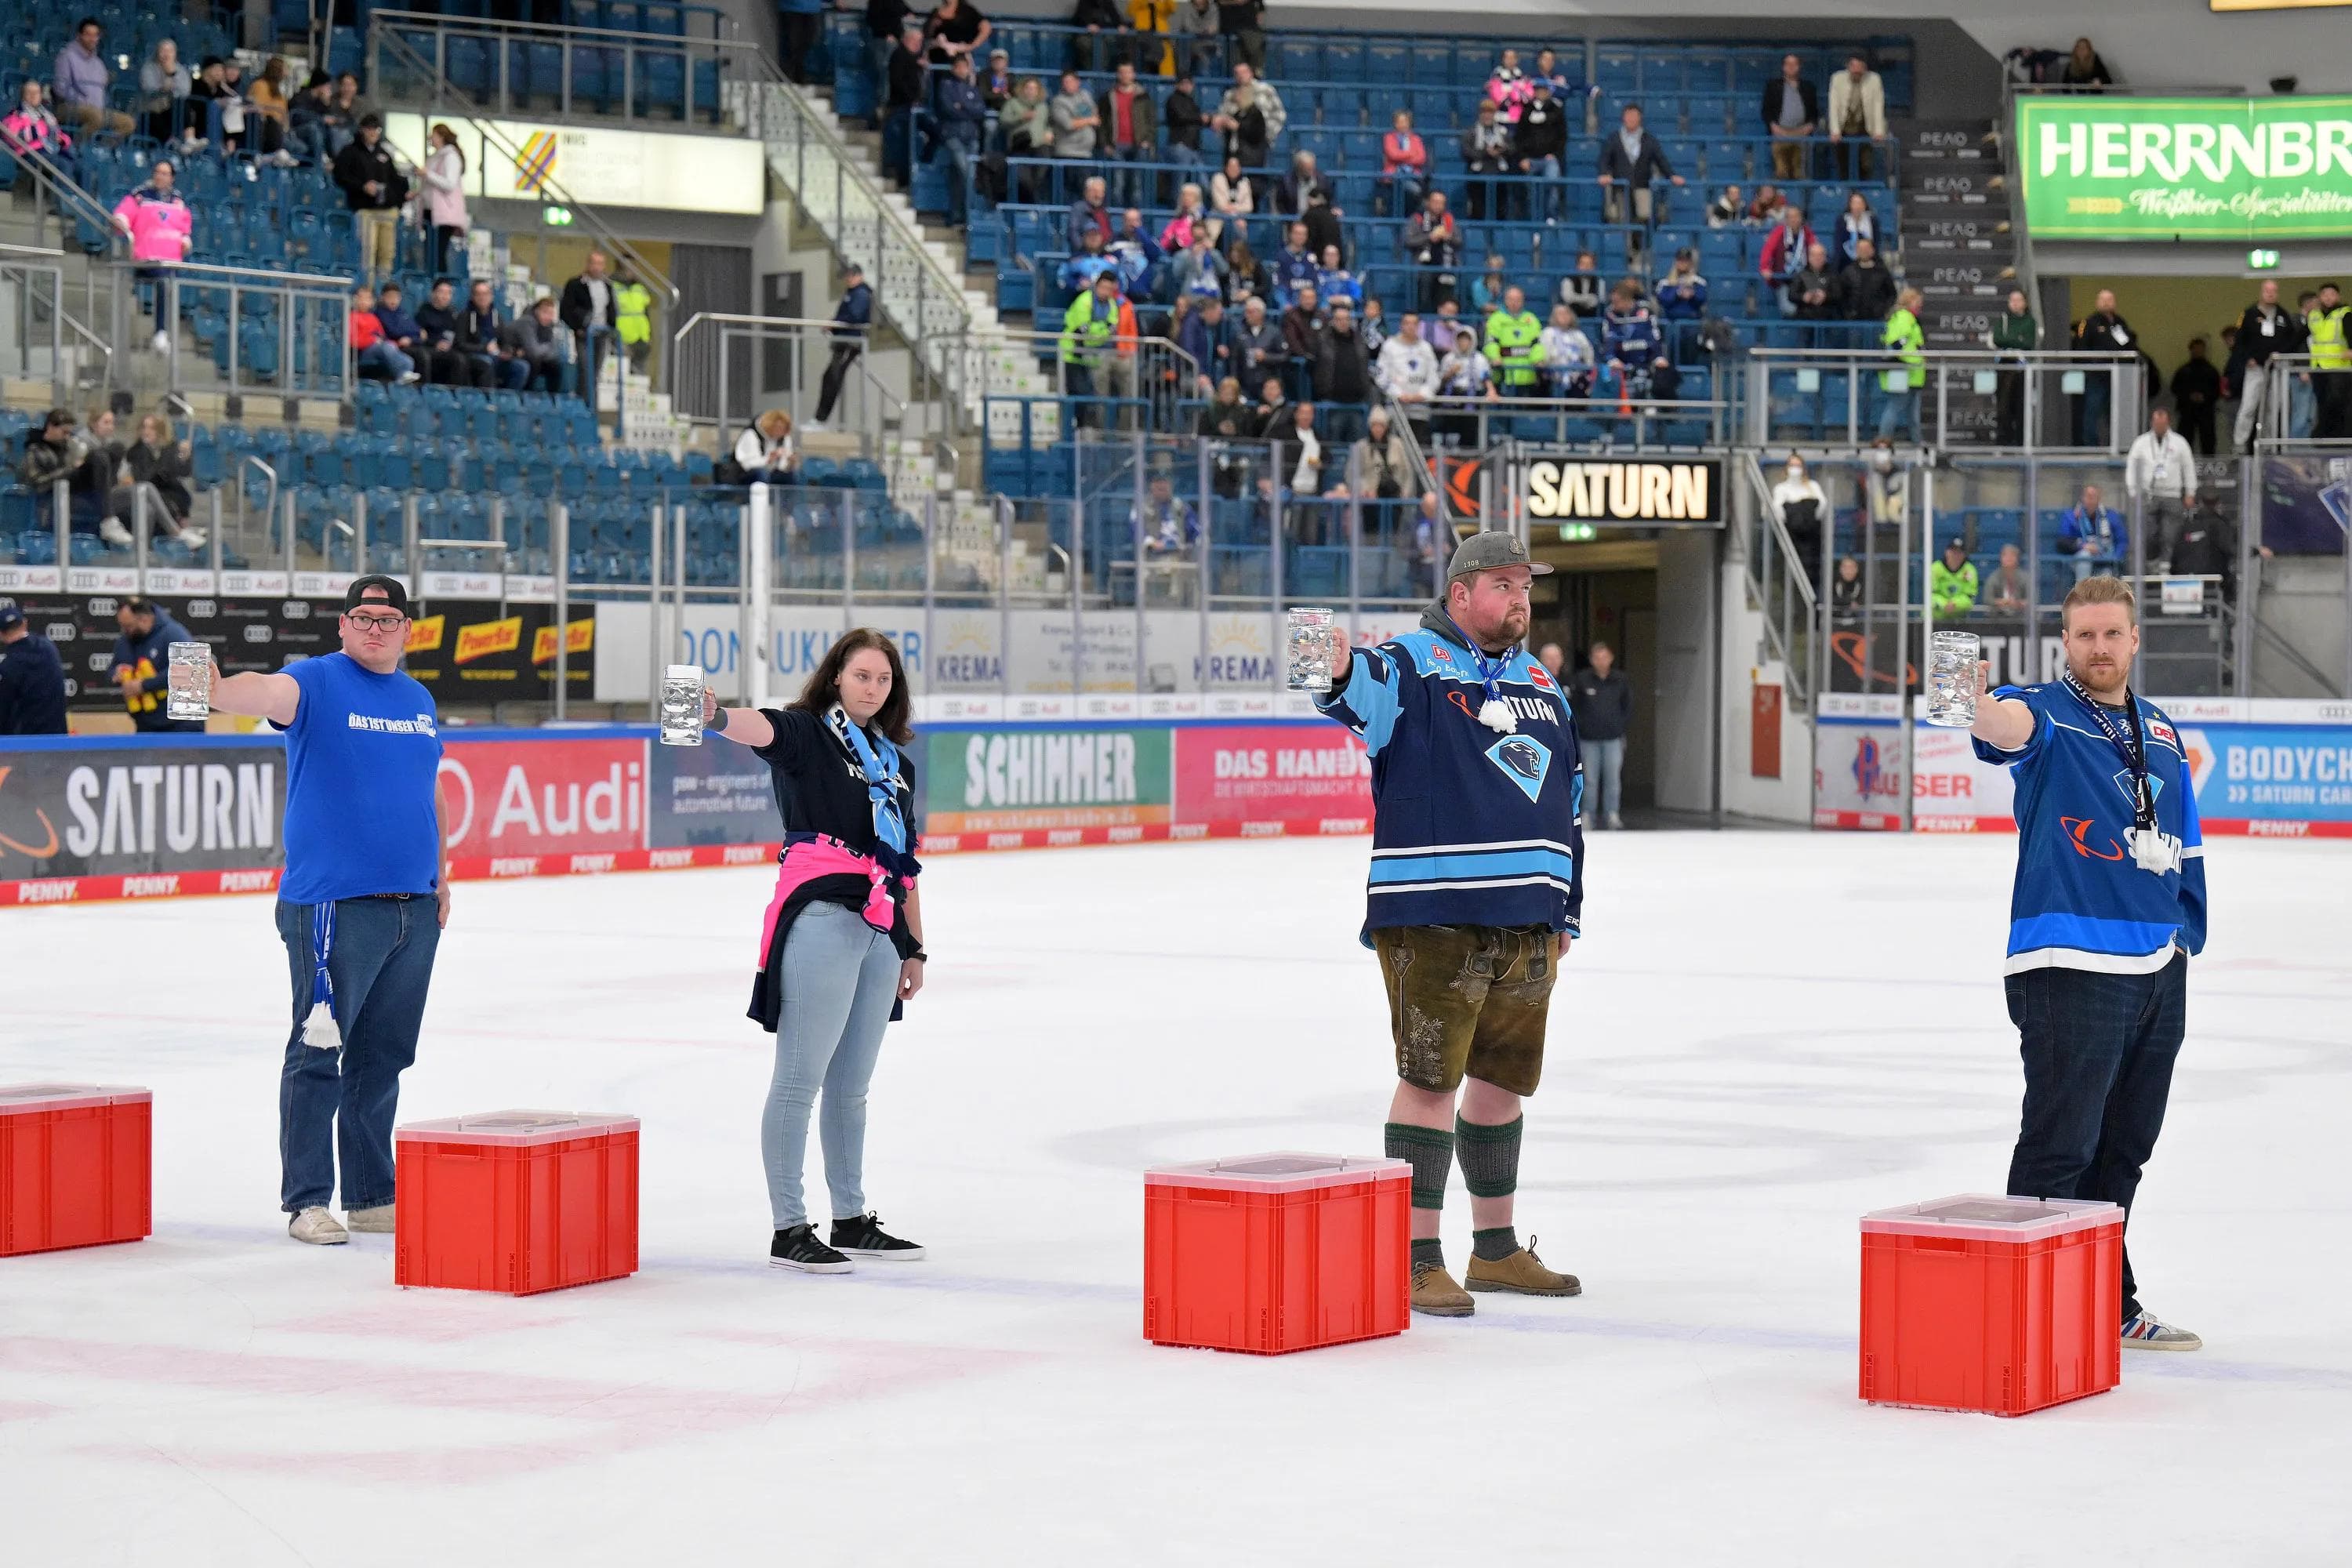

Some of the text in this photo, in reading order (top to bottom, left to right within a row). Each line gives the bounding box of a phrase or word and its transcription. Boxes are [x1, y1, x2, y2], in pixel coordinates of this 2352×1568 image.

[1529, 461, 1708, 519] SATURN
[936, 655, 1003, 681] KREMA
[1192, 655, 1274, 681] KREMA
[348, 712, 368, 728] DAS
[368, 716, 386, 731] IST
[386, 719, 415, 733] UNSER
[964, 733, 1137, 808] SCHIMMER
[1215, 750, 1268, 779] DAS
[2227, 746, 2352, 782] BODYCH
[489, 762, 640, 839] Audi
[2252, 786, 2315, 804] SATURN
[66, 763, 274, 858] SATURN
[1915, 817, 1976, 833] PENNY
[2249, 819, 2310, 837] PENNY
[19, 880, 78, 903] PENNY
[122, 874, 180, 898] PENNY
[220, 870, 274, 891] PENNY
